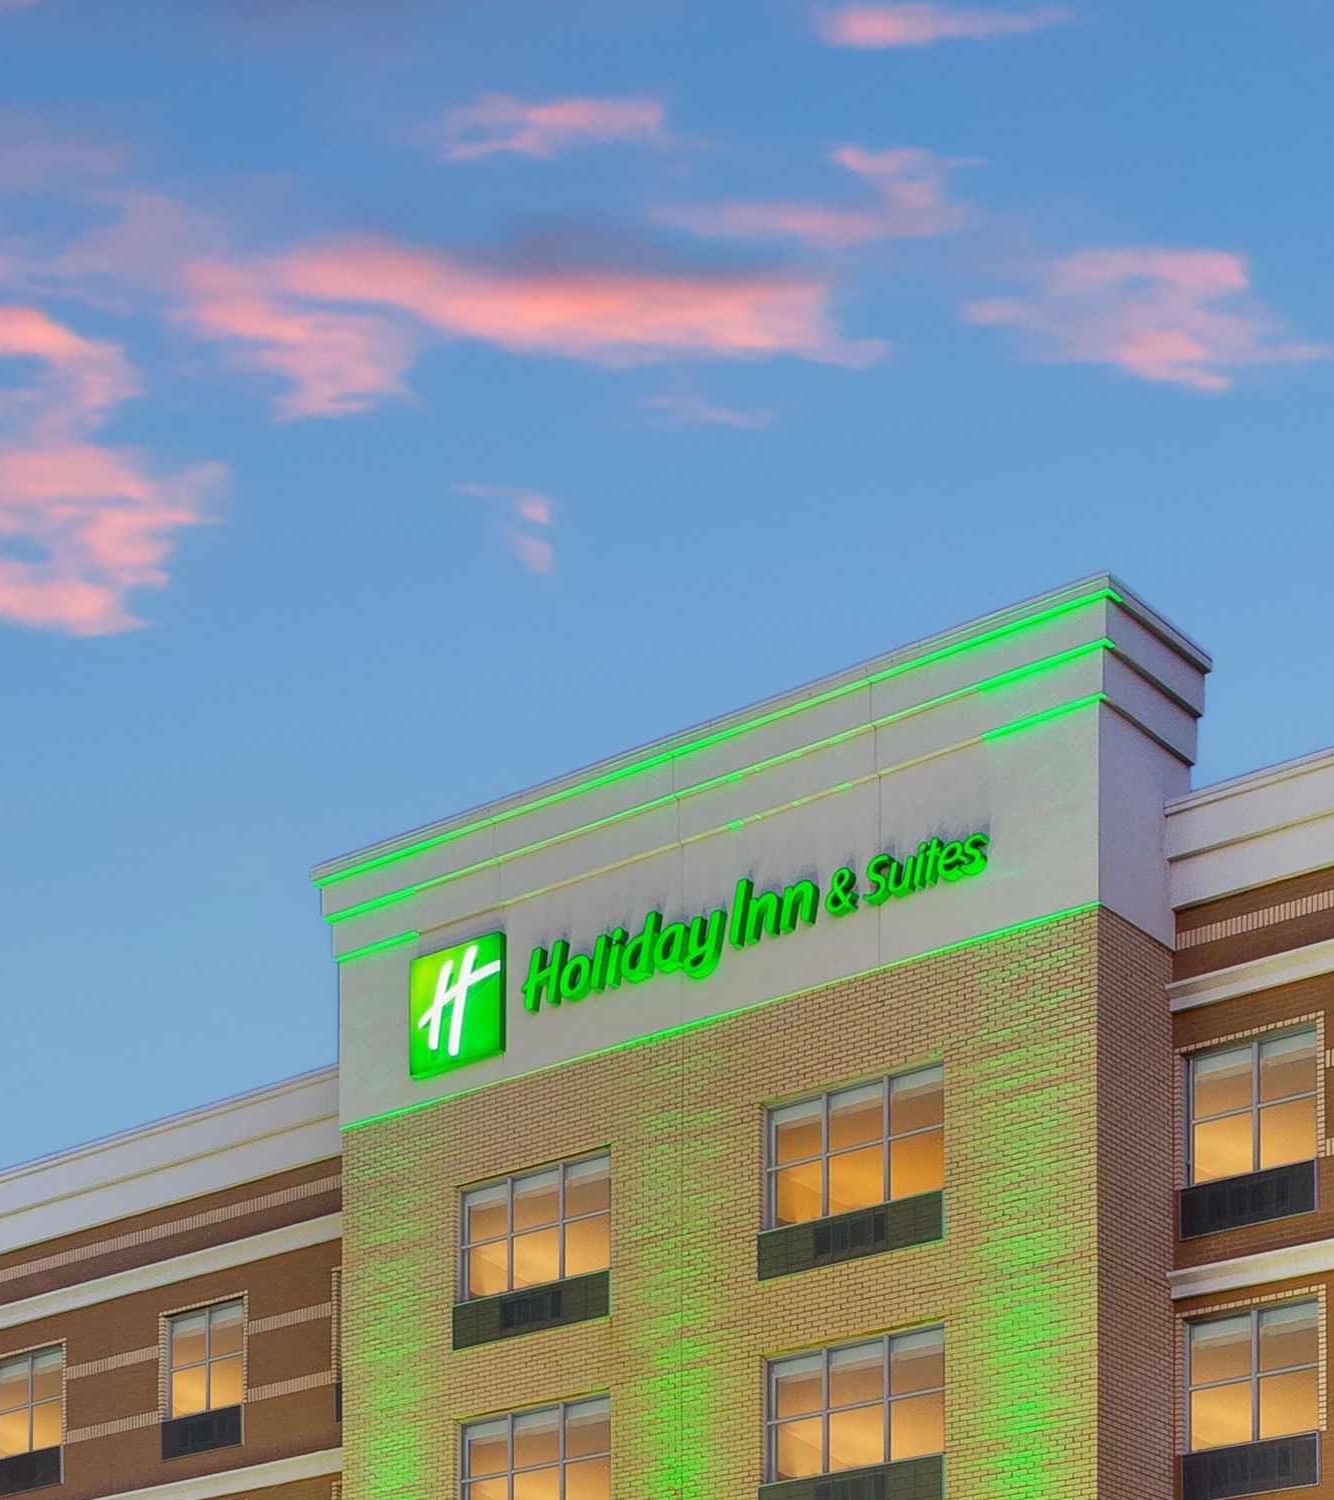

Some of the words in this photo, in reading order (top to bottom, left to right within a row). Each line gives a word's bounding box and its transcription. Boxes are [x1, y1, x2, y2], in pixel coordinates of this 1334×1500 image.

[521, 910, 727, 1014] Holiday
[729, 878, 820, 949] Inn
[825, 867, 859, 917] &
[863, 833, 989, 905] Suites
